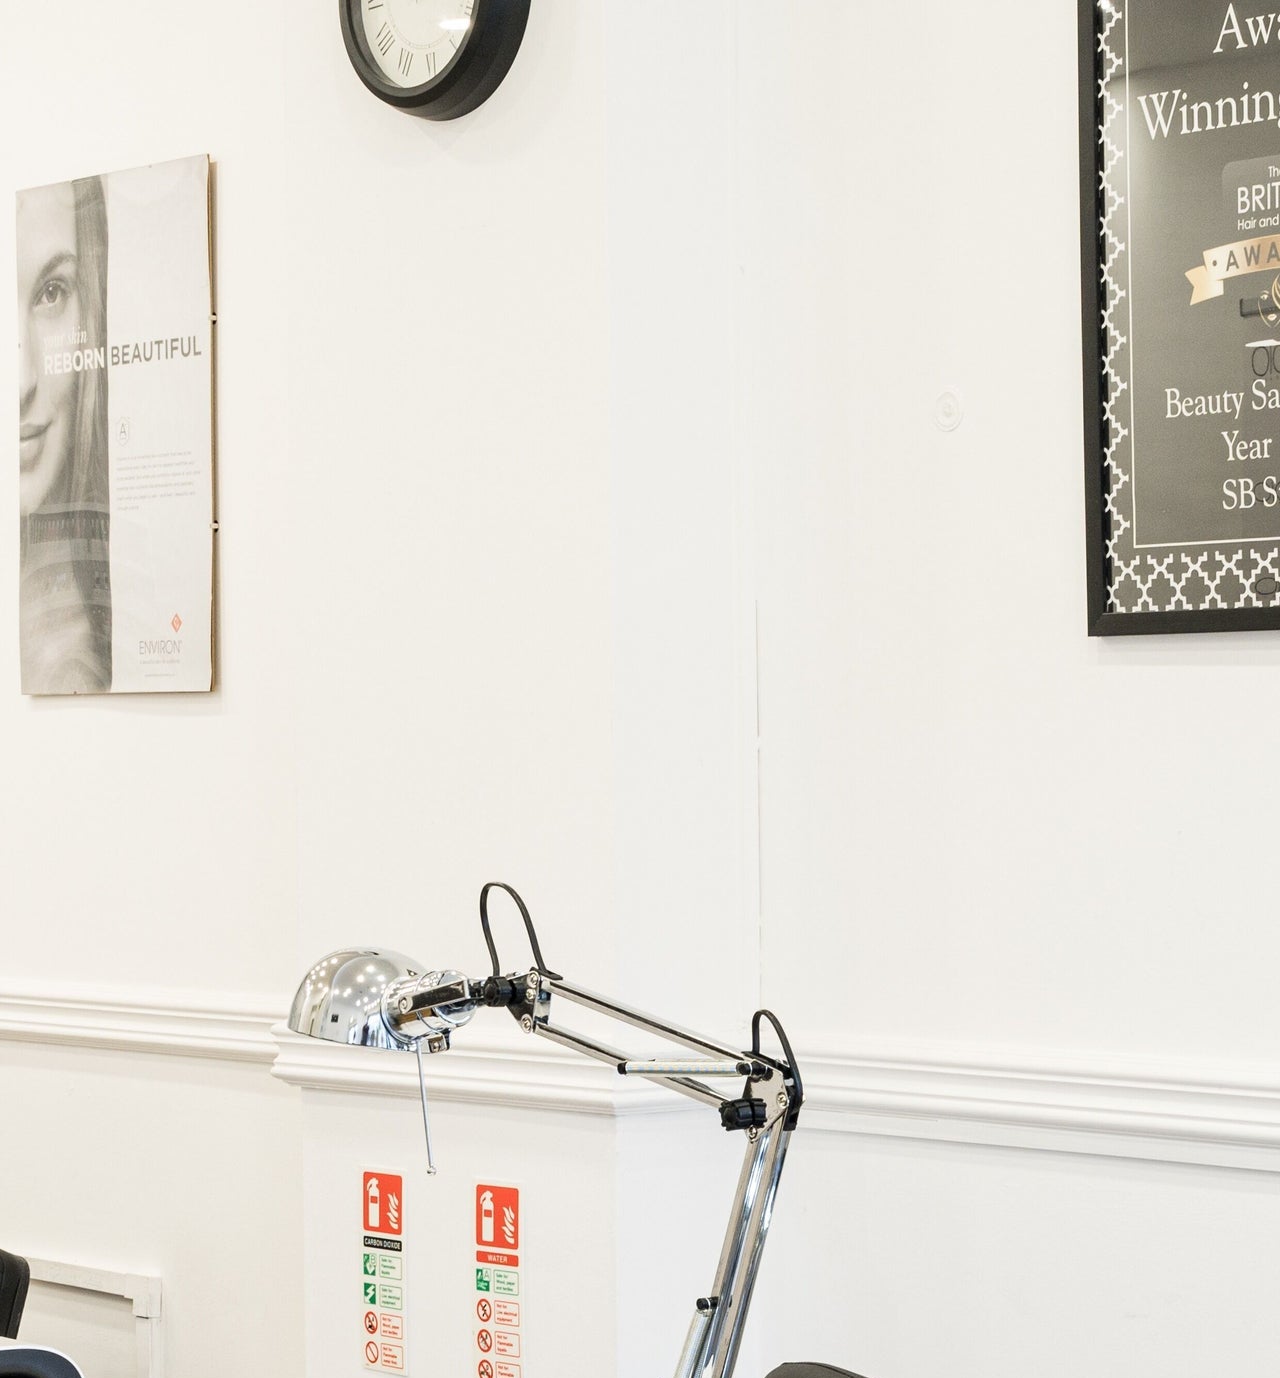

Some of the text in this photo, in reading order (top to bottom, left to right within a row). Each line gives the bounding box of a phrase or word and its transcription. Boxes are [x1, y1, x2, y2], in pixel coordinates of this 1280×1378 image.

[1237, 214, 1256, 231] Hair
[1259, 213, 1280, 227] and
[44, 335, 202, 375] REBORN BEAUTIFUL
[1165, 388, 1244, 419] Beauty
[1221, 429, 1273, 461] Year
[1222, 478, 1256, 510] SB
[138, 639, 182, 655] ENVIRON
[487, 1254, 508, 1264] WATER
